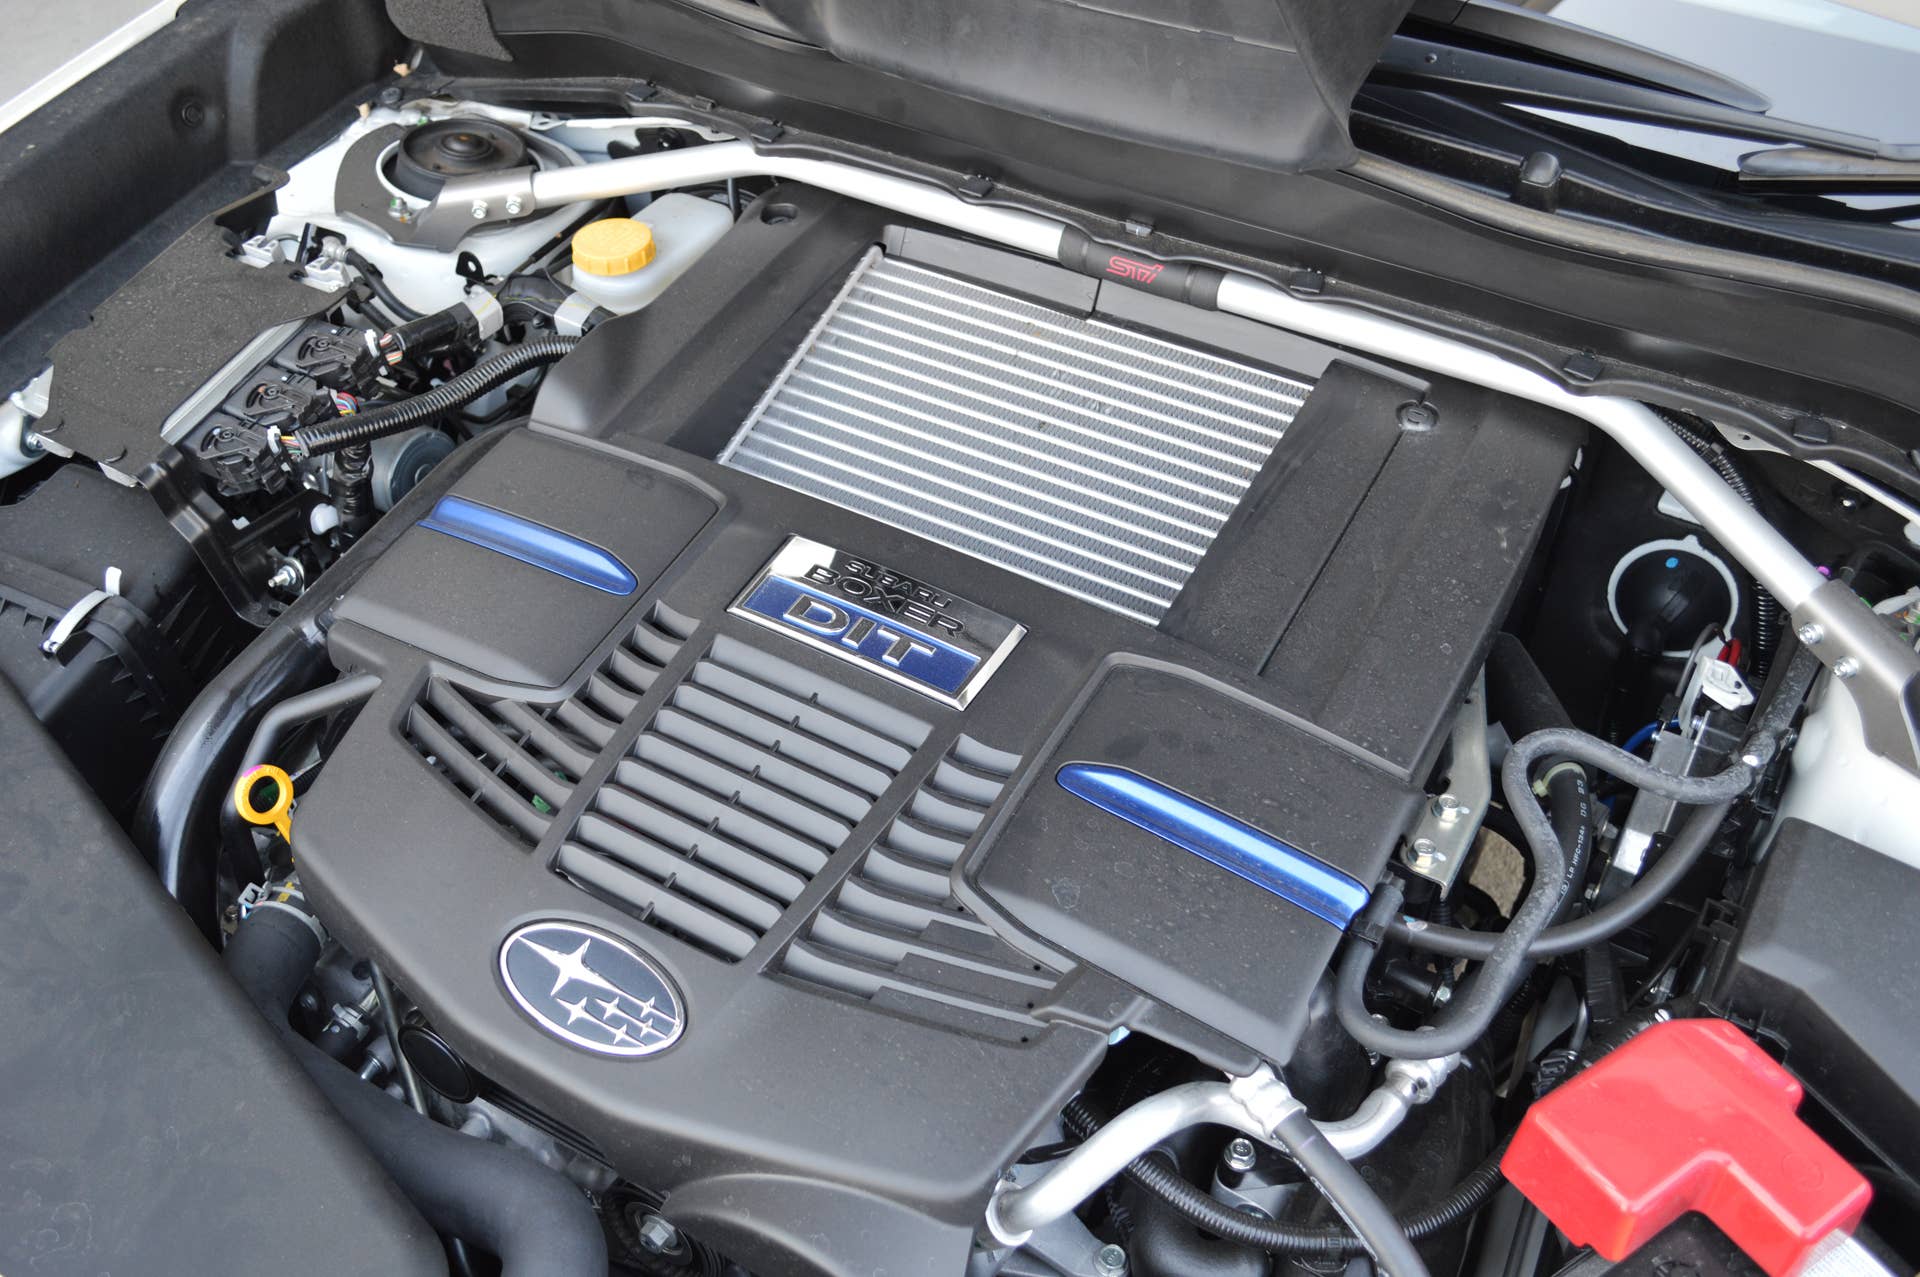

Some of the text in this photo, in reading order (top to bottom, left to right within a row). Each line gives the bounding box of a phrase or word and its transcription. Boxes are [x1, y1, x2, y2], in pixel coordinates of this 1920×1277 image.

[803, 563, 964, 640] BOXER
[844, 559, 953, 609] SUBARU
[783, 593, 937, 667] DIT
